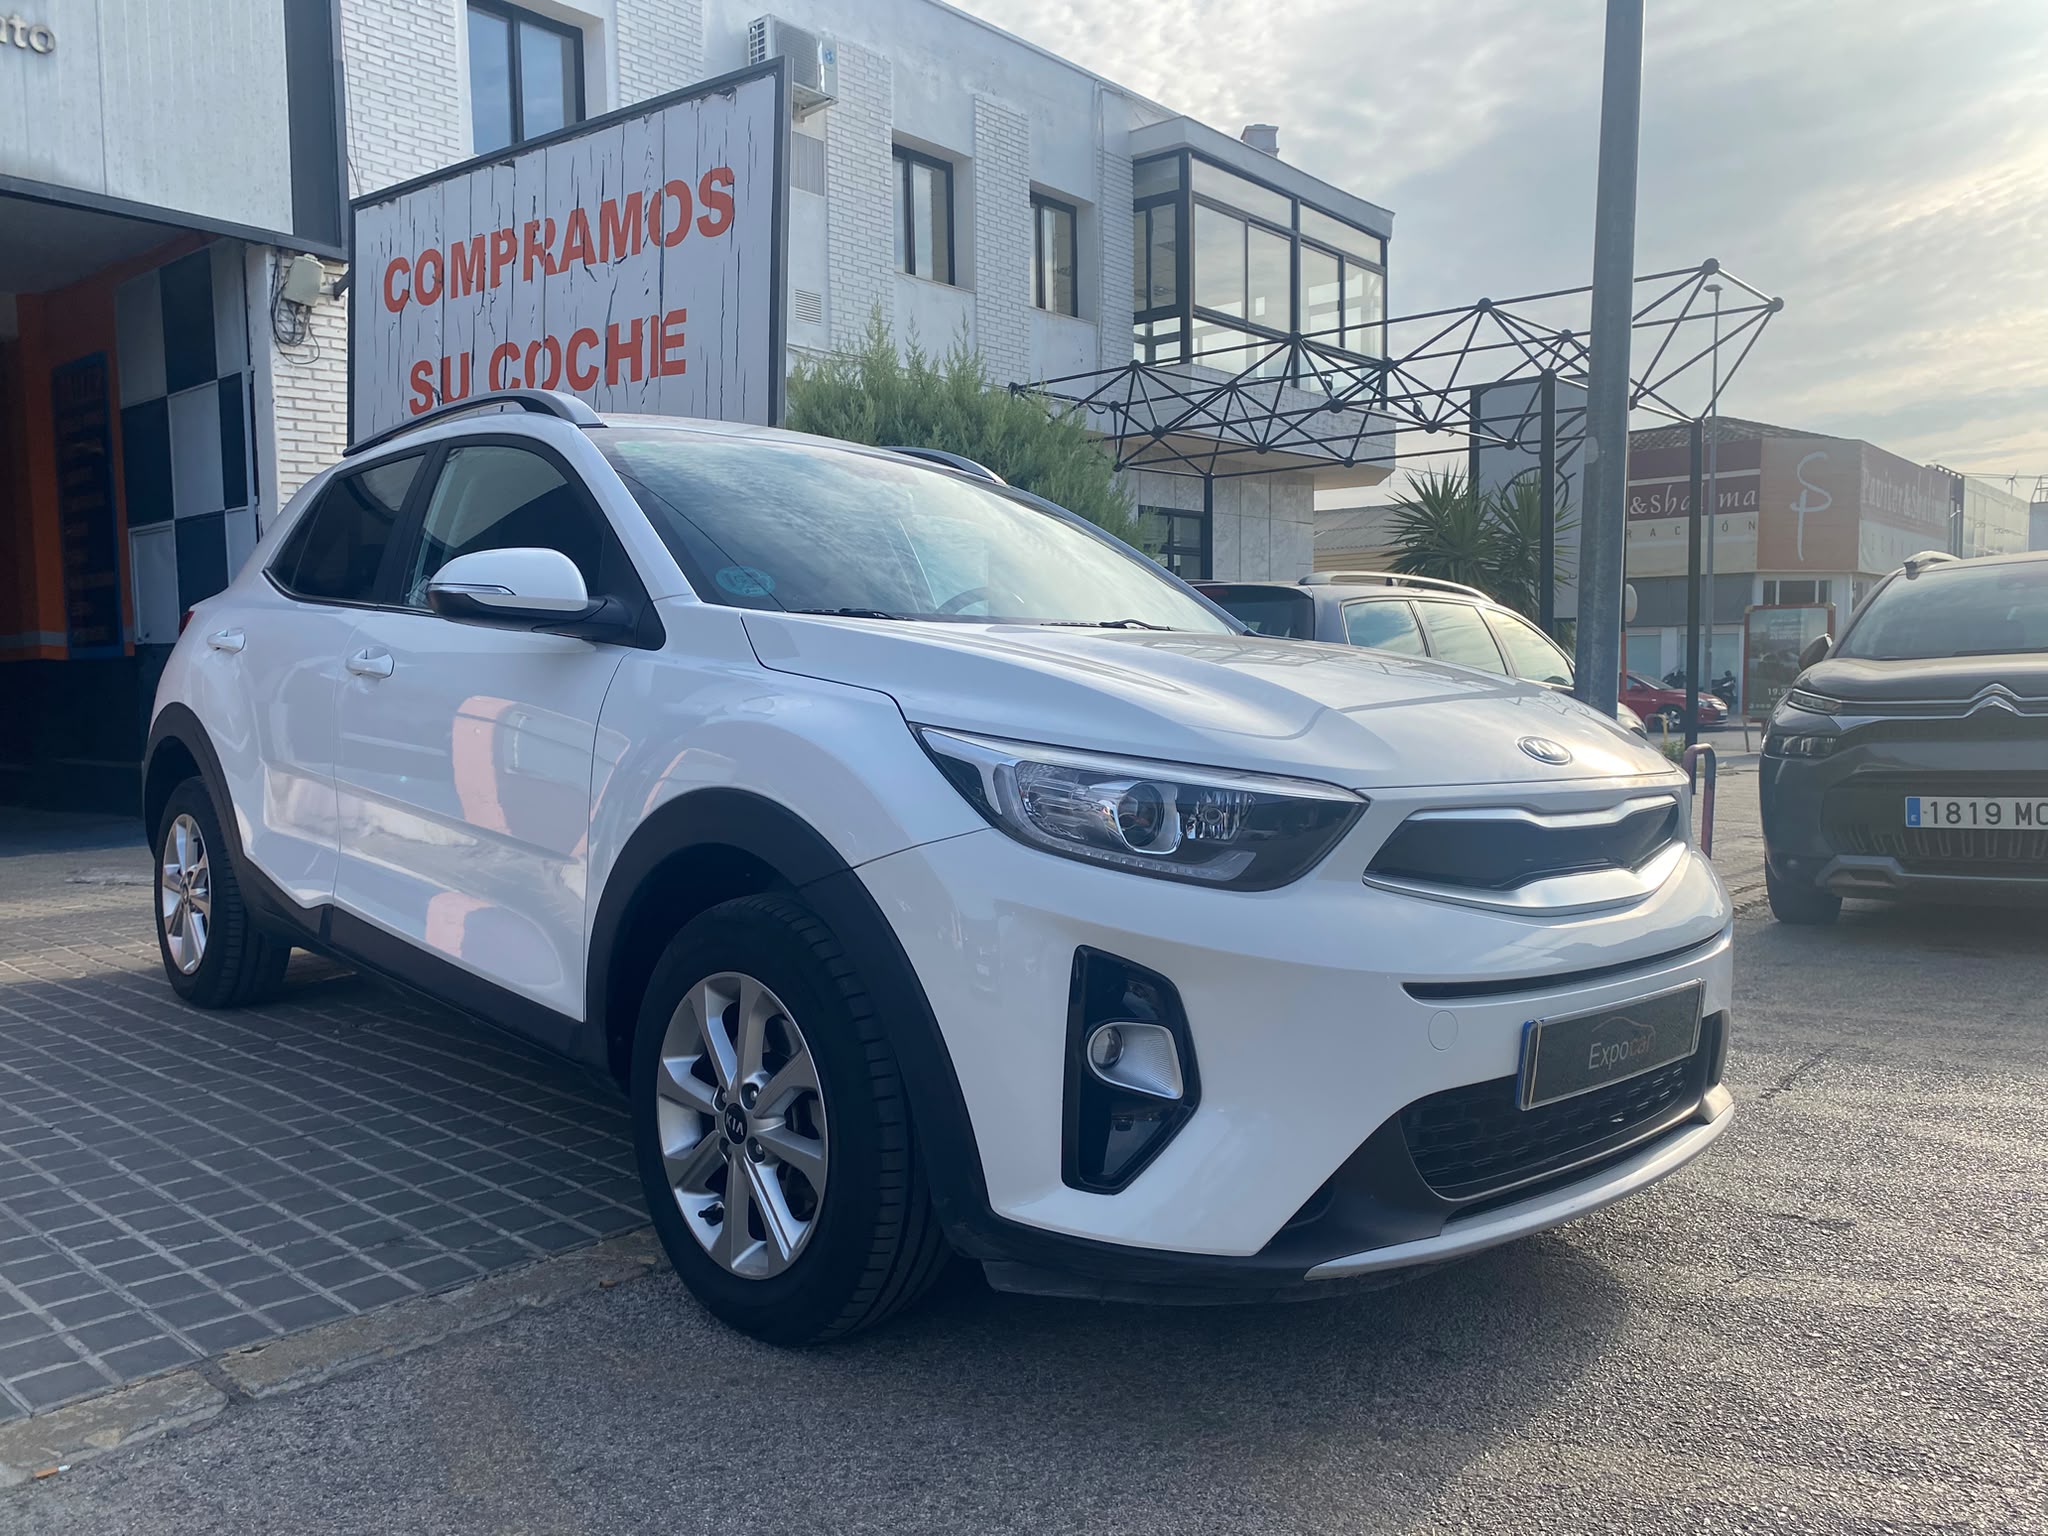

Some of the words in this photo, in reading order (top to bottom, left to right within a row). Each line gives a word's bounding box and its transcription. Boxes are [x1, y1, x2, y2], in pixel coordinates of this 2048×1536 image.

[384, 167, 735, 312] COMPRAMOS
[409, 352, 469, 414] SU
[489, 308, 688, 391] COCHE
[1930, 801, 2001, 825] 1819
[726, 1112, 744, 1136] KIA
